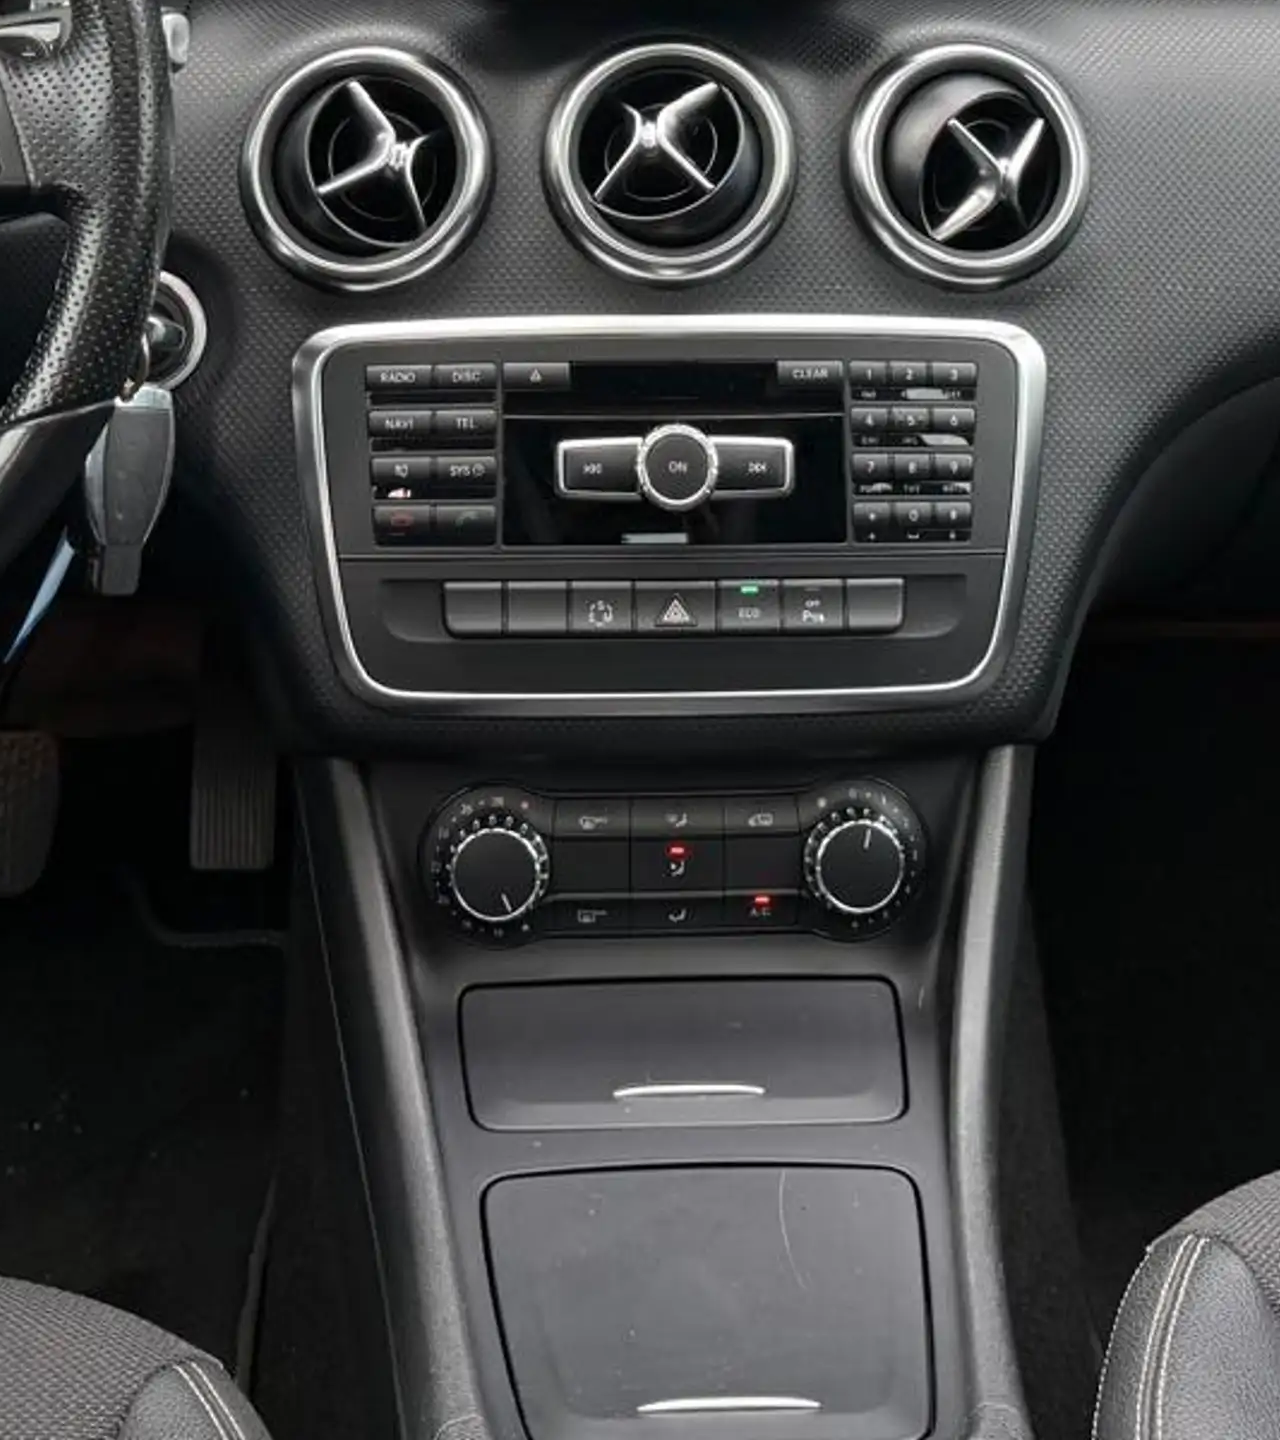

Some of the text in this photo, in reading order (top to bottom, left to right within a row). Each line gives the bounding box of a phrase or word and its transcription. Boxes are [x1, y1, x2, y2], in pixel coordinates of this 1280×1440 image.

[380, 371, 416, 383] RADIO
[452, 371, 481, 382] DISC
[792, 368, 829, 379] CLEAR
[906, 369, 913, 380] 2
[385, 419, 414, 429] NAVI
[456, 418, 477, 429] TEL
[865, 414, 874, 426] 4
[949, 415, 959, 427] 6
[450, 464, 470, 477] SYS
[669, 461, 687, 474] ON
[949, 462, 959, 475] 9
[908, 510, 918, 522] 0
[738, 608, 760, 619] ECO
